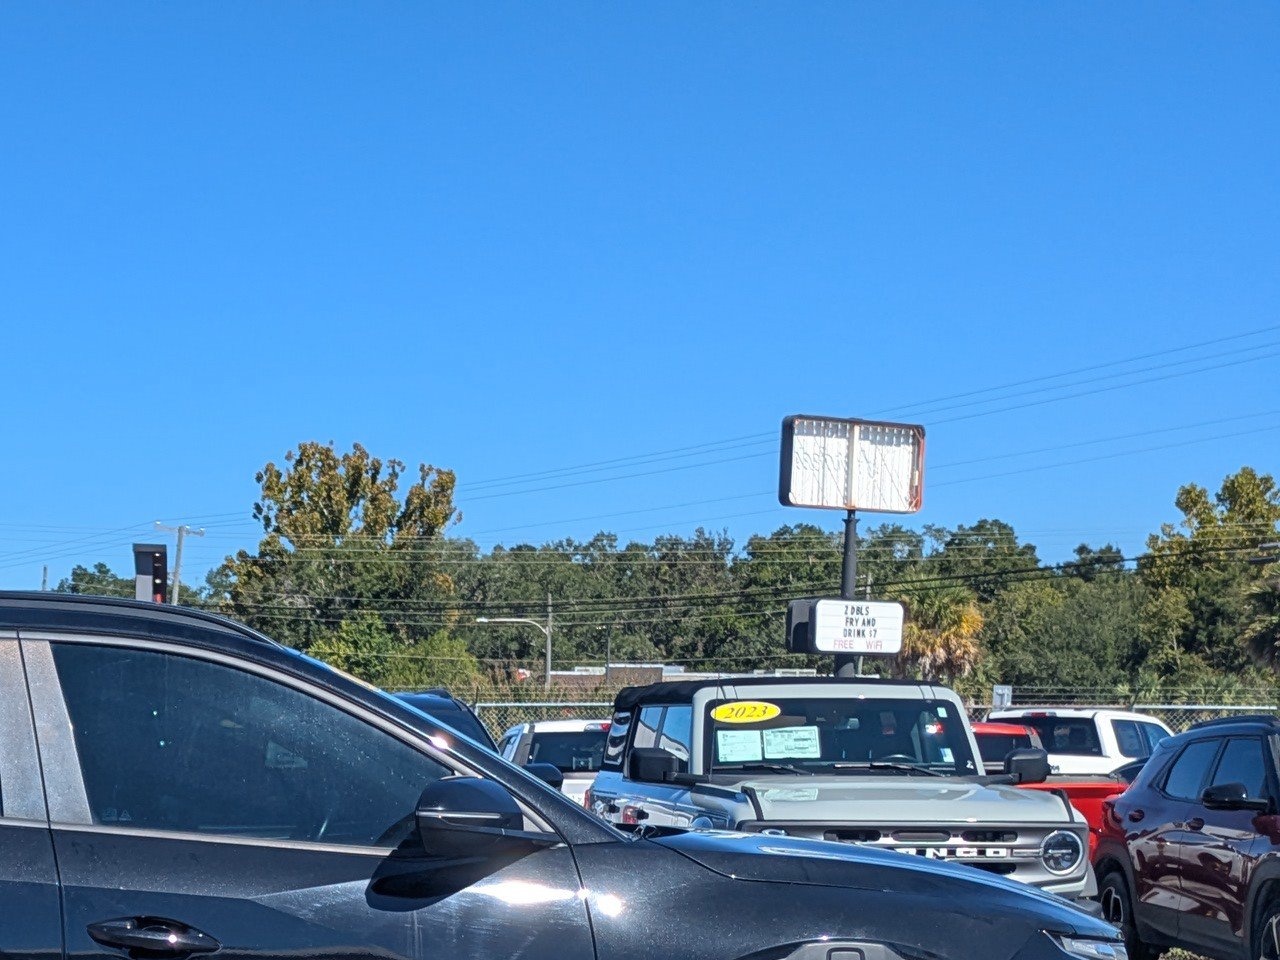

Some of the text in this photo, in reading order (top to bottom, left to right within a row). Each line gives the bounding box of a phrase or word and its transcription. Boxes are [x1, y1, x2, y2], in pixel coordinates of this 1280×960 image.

[844, 605, 869, 616] 2 DBLS
[845, 617, 876, 628] FRY AND
[843, 629, 878, 639] DRINK $7
[833, 640, 854, 650] FREE
[724, 706, 768, 719] 2023
